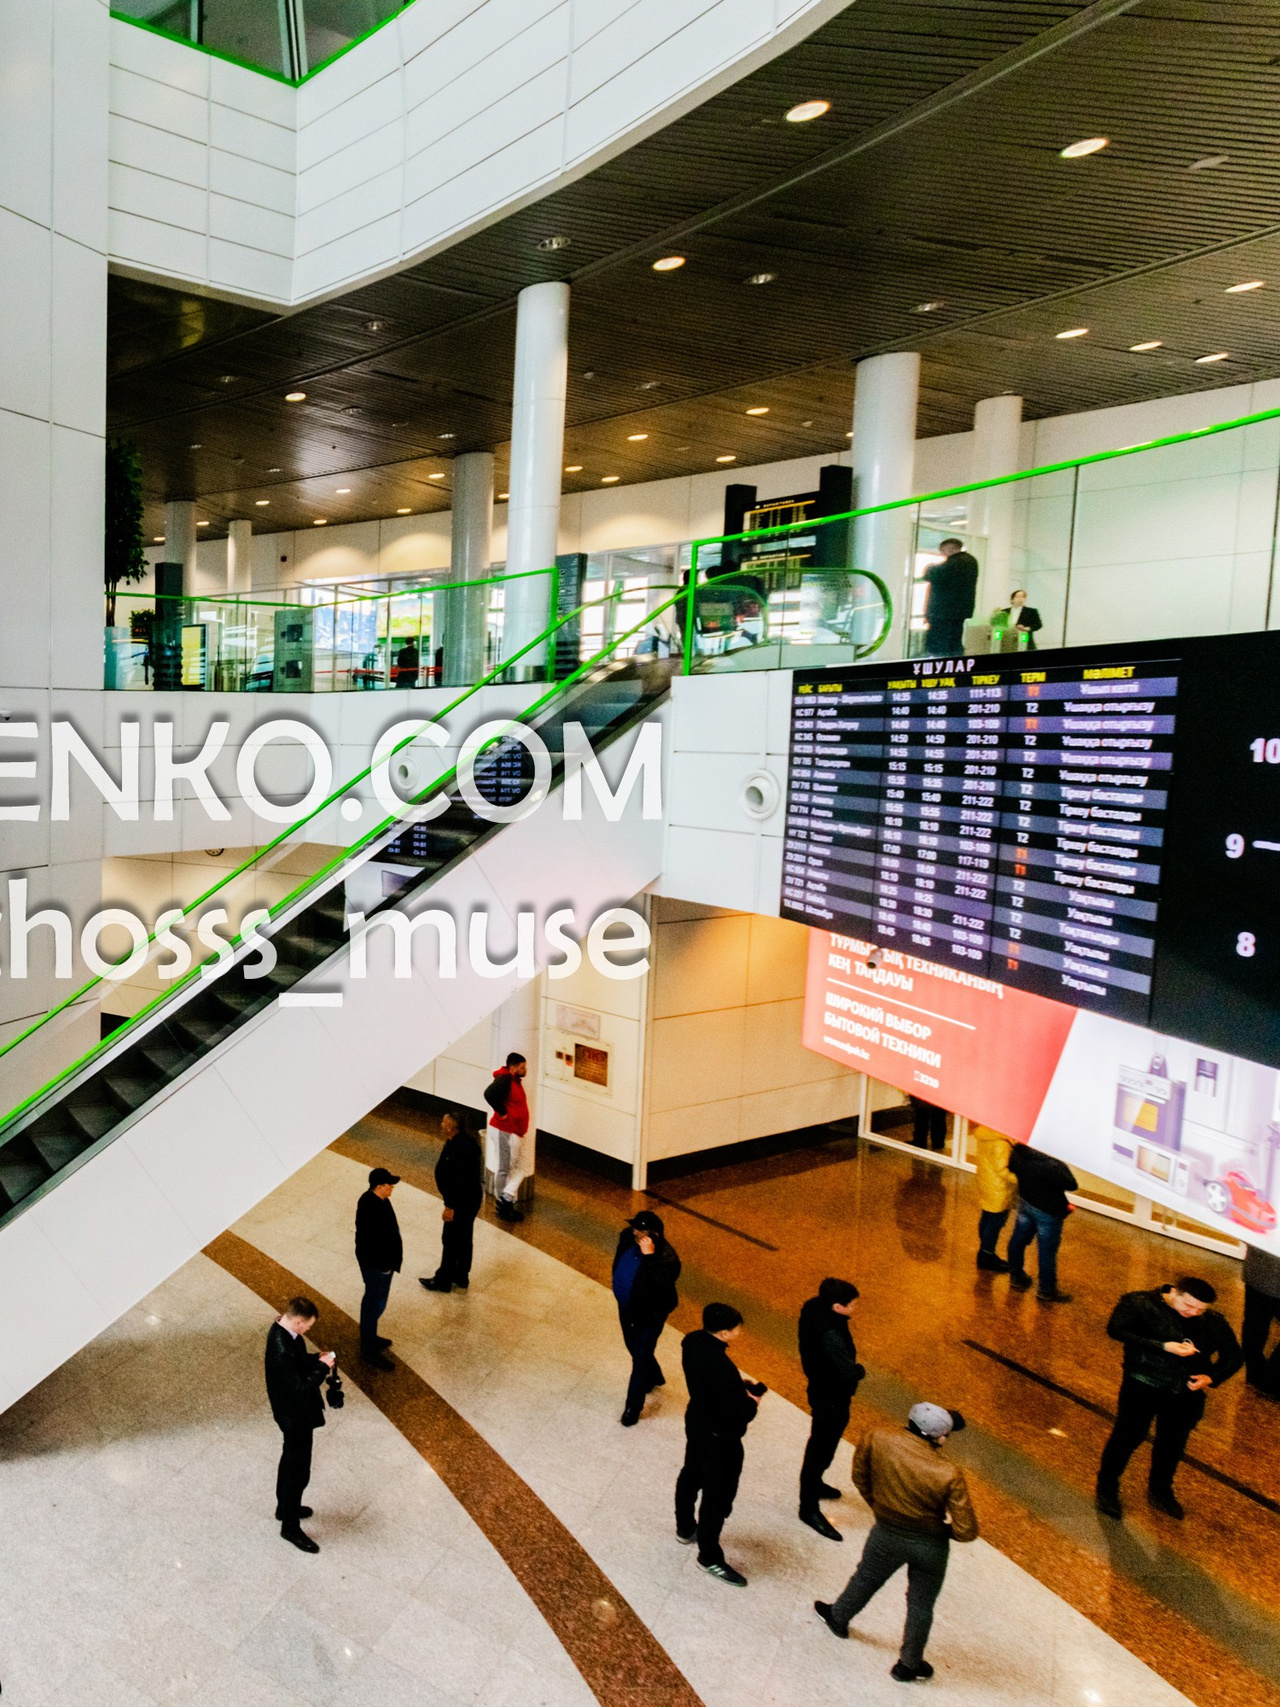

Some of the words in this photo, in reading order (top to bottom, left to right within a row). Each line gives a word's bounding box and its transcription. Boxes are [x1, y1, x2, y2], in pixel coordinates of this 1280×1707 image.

[968, 703, 1000, 714] 201-210
[966, 734, 998, 745] 201-210
[964, 764, 996, 776] 201-210
[961, 795, 994, 807] 211-222
[959, 825, 992, 838] 211-222
[1225, 833, 1245, 859] 9
[958, 855, 989, 869] 117-119
[954, 884, 987, 900] 211-222
[952, 914, 985, 930] 211-222
[951, 944, 983, 960] 103-109
[1236, 931, 1256, 958] 8
[828, 953, 851, 975] КЕҢ
[825, 991, 884, 1025] ШИРОКИЙ
[885, 1012, 932, 1040] ВЫБОР
[824, 1011, 880, 1044] БЫТОВОЙ
[881, 1032, 942, 1068] ТЕХНИКИ
